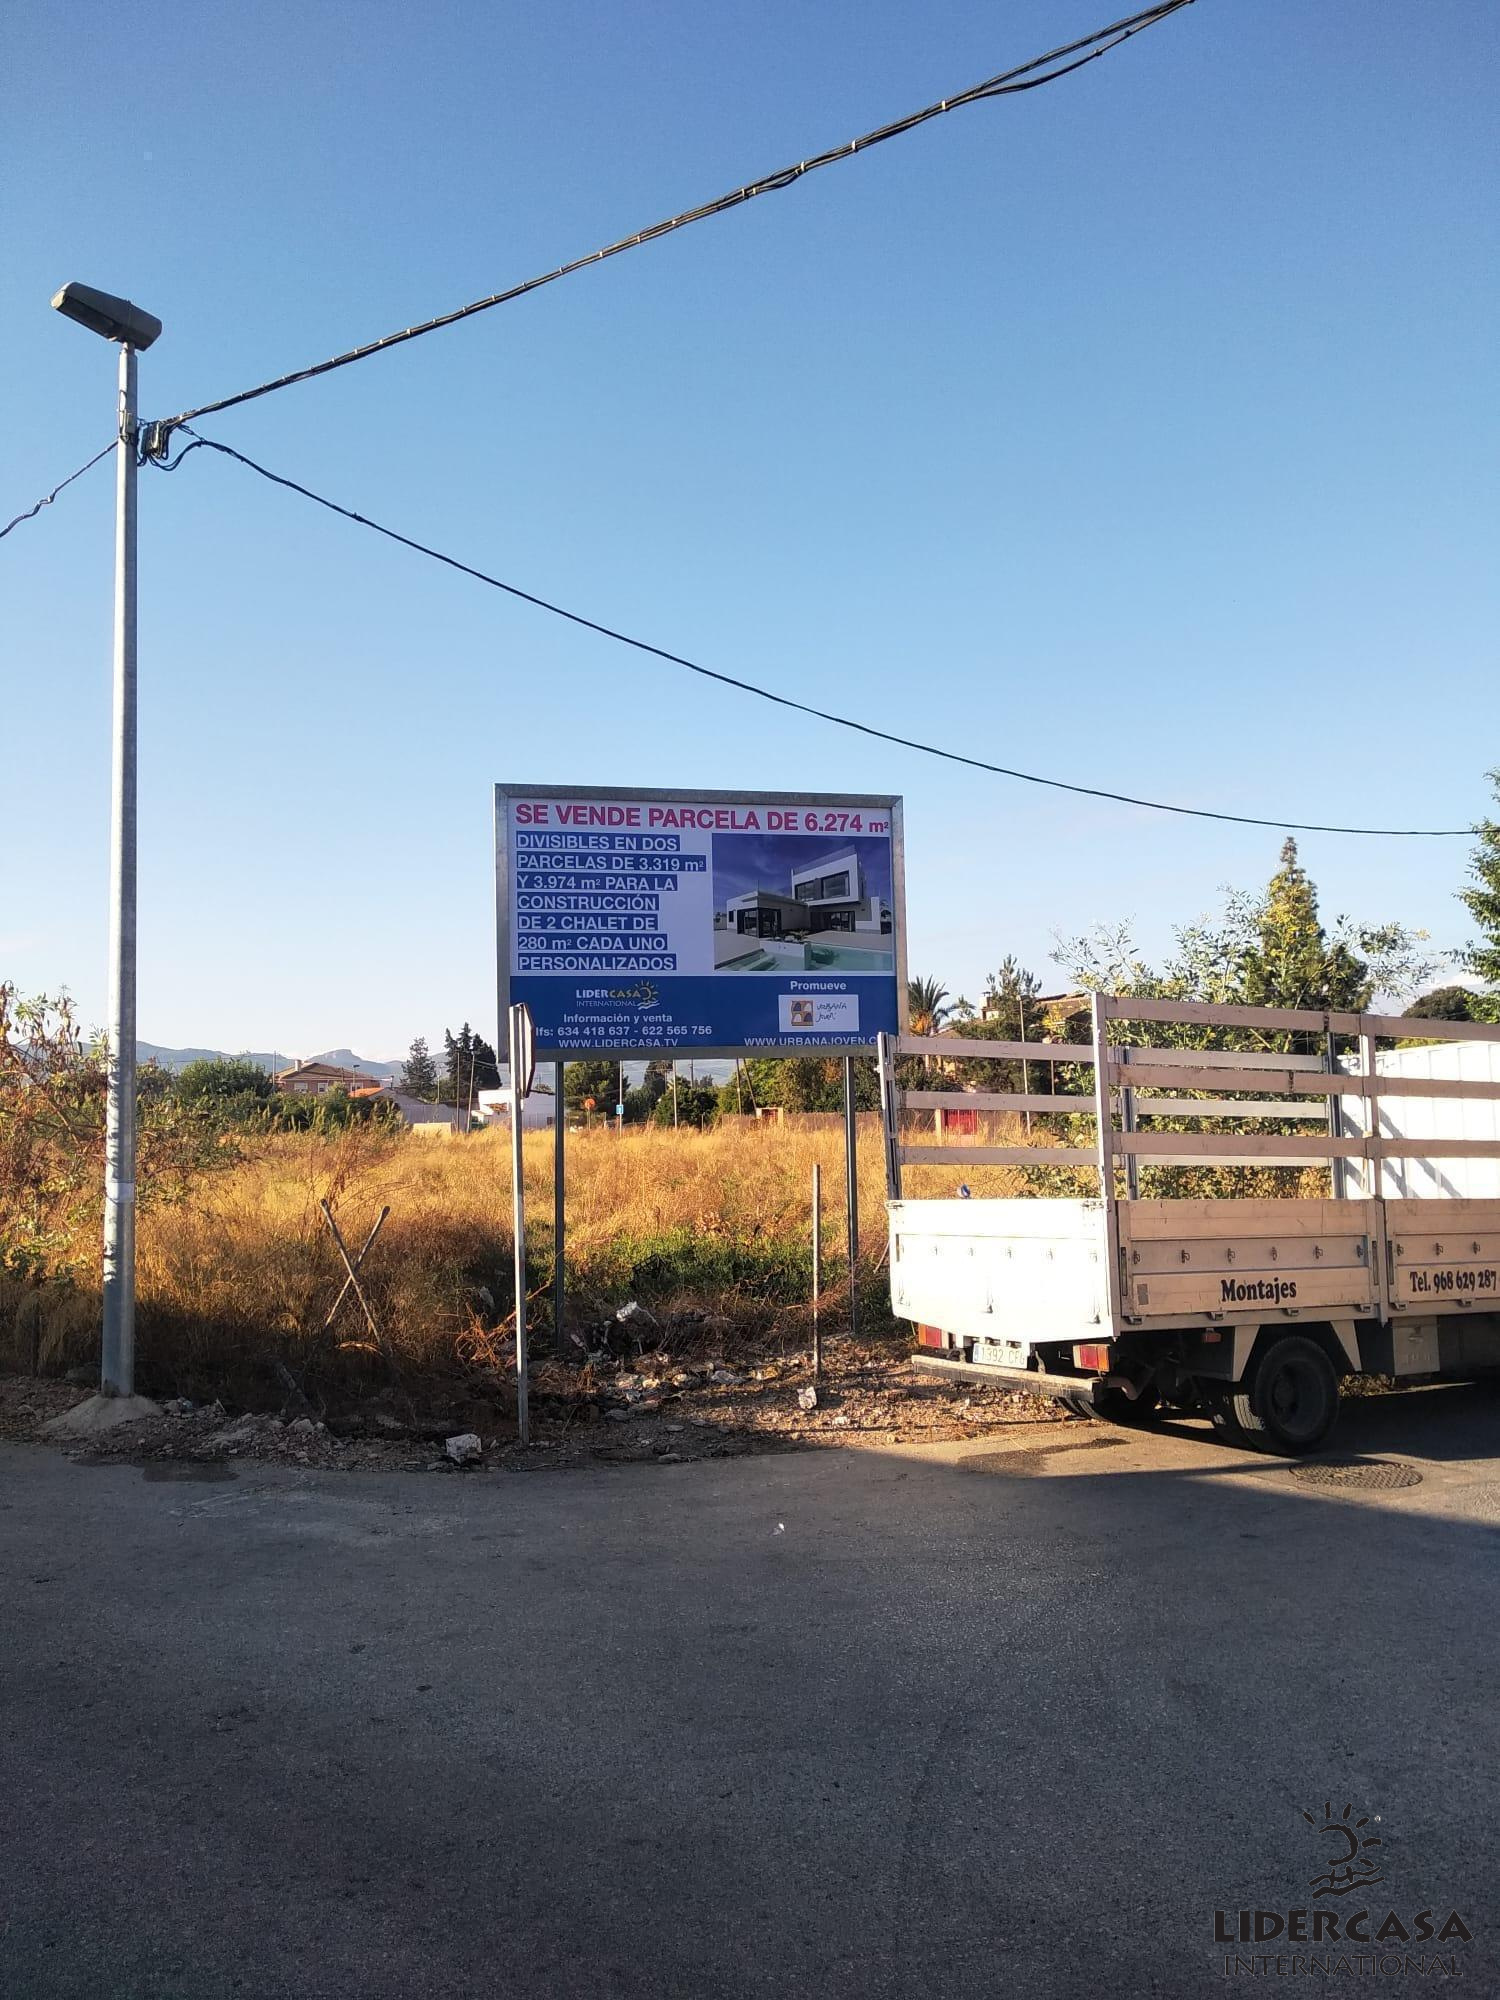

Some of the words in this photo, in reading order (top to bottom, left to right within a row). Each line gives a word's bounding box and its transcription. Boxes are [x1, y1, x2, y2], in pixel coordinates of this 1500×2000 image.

[516, 804, 548, 824] SE
[555, 805, 641, 826] VENDE
[649, 808, 760, 830] PARCELA
[767, 811, 798, 830] DE
[804, 813, 862, 832] 6.274
[517, 834, 609, 849] DIVISIBLES
[614, 837, 638, 850] EN
[642, 838, 677, 851] DOS
[517, 854, 607, 869] PARCELAS
[612, 857, 634, 870] DE
[639, 858, 680, 871] 3.319
[518, 876, 529, 887] Y
[533, 876, 576, 889] 3.974
[605, 877, 650, 890] PARA
[654, 878, 675, 891] LA
[518, 893, 656, 910] CONSTRUCCIÓN
[518, 916, 541, 929] DE
[546, 916, 556, 929] 2
[561, 916, 627, 930] CHALET
[633, 917, 656, 930] DE
[518, 936, 547, 949] 280
[577, 937, 624, 950] CADA
[629, 938, 666, 950] UNO
[518, 957, 674, 971] PERSONALIZADOS
[790, 981, 847, 991] Promueve
[576, 1000, 637, 1008] INTERNATIONAL
[563, 1013, 630, 1023] Información
[634, 1015, 640, 1024] y
[643, 1013, 673, 1023] venta
[535, 1027, 554, 1037] lfs:
[557, 1027, 579, 1036] 634
[583, 1026, 605, 1036] 418
[608, 1026, 630, 1036] 637
[642, 1026, 663, 1035] 622
[666, 1026, 688, 1035] 565
[691, 1026, 712, 1035] 756
[558, 1038, 678, 1049] WWW.LIDERCASA.TV
[1409, 1271, 1431, 1292] Tel.
[1433, 1270, 1454, 1294] 968
[1456, 1269, 1475, 1292] 629
[1477, 1269, 1496, 1291] 287
[1220, 1277, 1297, 1304] Montajes
